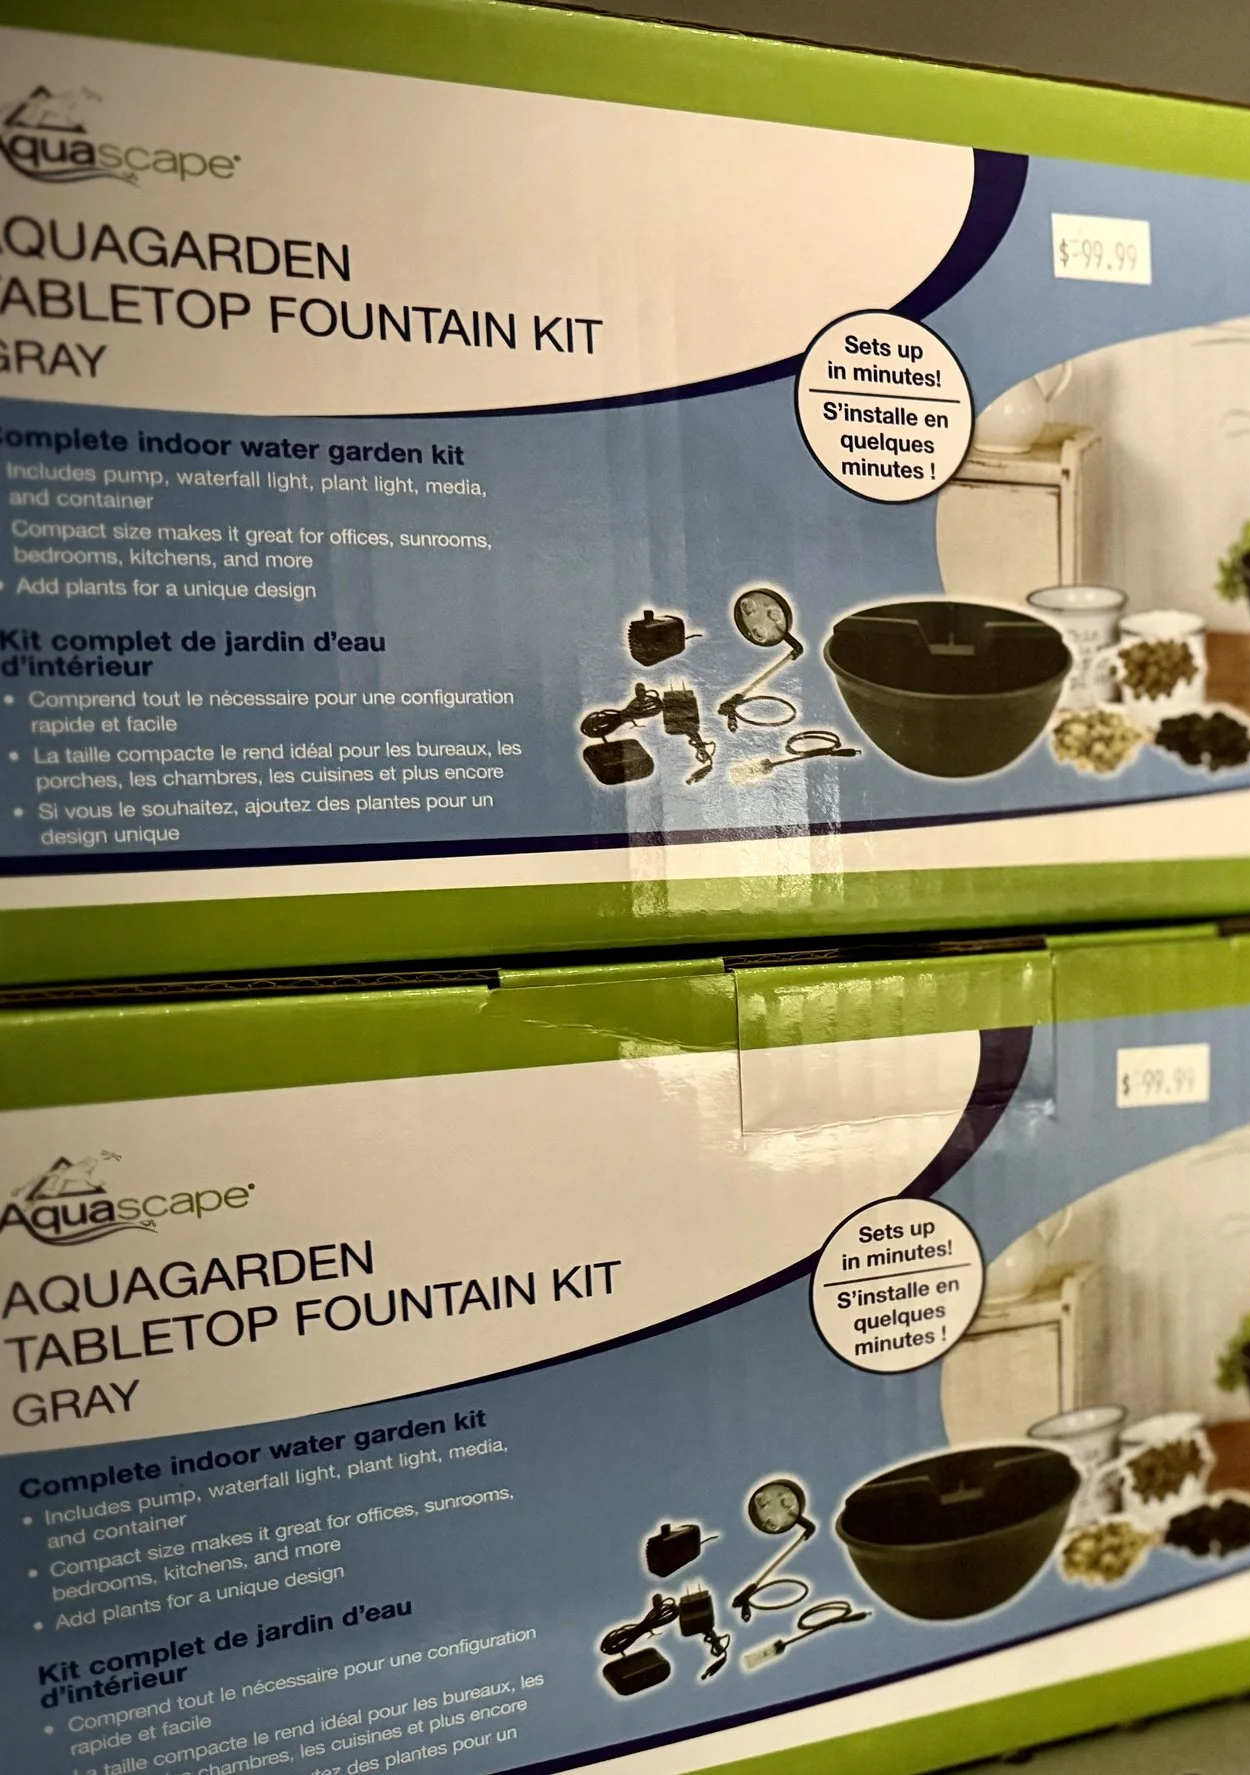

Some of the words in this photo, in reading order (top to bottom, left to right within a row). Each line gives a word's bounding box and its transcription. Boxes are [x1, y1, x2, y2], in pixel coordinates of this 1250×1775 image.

[0, 216, 350, 281] QUAGARDEN
[270, 296, 516, 349] FOUNTAIN
[534, 316, 603, 354] KIT
[845, 335, 890, 356] Sets
[898, 344, 923, 362] up
[828, 361, 846, 379] in
[854, 365, 941, 387] minutes!
[823, 402, 918, 425] S'installe
[925, 415, 948, 428] en
[138, 430, 231, 457] indoor
[240, 441, 319, 461] water
[329, 441, 422, 465] garden
[433, 443, 464, 465] kit
[841, 433, 935, 455] quelques
[104, 471, 169, 488] pump,
[177, 470, 259, 488] waterfall
[268, 473, 313, 492] light,
[321, 475, 368, 494] plant
[375, 476, 418, 496] light,
[426, 479, 486, 498] media,
[57, 491, 153, 510] container
[114, 524, 151, 541] size
[158, 525, 221, 542] makes
[246, 528, 292, 547] great
[300, 527, 324, 545] for
[330, 529, 393, 548] offices,
[400, 532, 491, 550] sunrooms,
[130, 550, 216, 570] kitchens,
[224, 552, 258, 569] and
[265, 556, 313, 570] more
[16, 579, 60, 595] Add
[66, 579, 126, 598] plants
[134, 580, 159, 596] for
[184, 581, 248, 600] unique
[255, 581, 316, 600] design
[0, 630, 40, 651] Kit
[51, 632, 171, 656] complet
[181, 632, 216, 652] de
[226, 631, 304, 656] jardin
[29, 691, 136, 710] Comprend
[143, 692, 181, 707] tout
[210, 689, 309, 707] nécessaire
[316, 692, 357, 709] pour
[363, 691, 395, 704] une
[401, 689, 513, 708] configuration
[32, 717, 94, 737] rapide
[127, 715, 176, 733] facile
[65, 748, 110, 763] taille
[117, 747, 214, 766] compacte
[243, 744, 283, 760] rend
[290, 743, 332, 760] idéal
[339, 746, 381, 763] pour
[386, 743, 410, 758] les
[417, 742, 491, 760] bureaux,
[498, 741, 521, 756] les
[37, 773, 122, 792] porches,
[130, 772, 156, 786] les
[163, 769, 262, 787] chambres,
[269, 768, 294, 783] les
[301, 767, 374, 782] cuisines
[403, 765, 439, 784] plus
[445, 765, 504, 780] encore
[65, 805, 113, 818] vous
[143, 799, 239, 818] souhaitez,
[245, 798, 311, 816] ajoutez
[317, 796, 350, 812] des
[356, 794, 421, 814] plantes
[427, 794, 466, 811] pour
[41, 827, 107, 846] design
[114, 826, 180, 845] unique
[859, 1225, 903, 1243] Sets
[911, 1221, 935, 1238] up
[842, 1254, 860, 1270] in
[867, 1239, 952, 1267] minutes!
[2, 1240, 374, 1319] AQUAGARDEN
[838, 1282, 929, 1309] S'installe
[936, 1280, 959, 1293] en
[5, 1305, 278, 1374] TABLETOP
[297, 1272, 536, 1336] FOUNTAIN
[552, 1260, 622, 1301] KIT
[854, 1305, 945, 1334] quelques
[13, 1379, 140, 1427] GRAY
[19, 1458, 161, 1500] Complete
[171, 1446, 261, 1476] indoor
[269, 1433, 346, 1460] water
[354, 1416, 446, 1452] garden
[454, 1410, 487, 1432] kit
[45, 1497, 131, 1526] Includes
[138, 1489, 201, 1513] pump,
[208, 1470, 289, 1499] waterfall
[296, 1465, 341, 1486] light,
[348, 1456, 393, 1478] plant
[399, 1448, 442, 1471] light,
[449, 1438, 508, 1460] media,
[47, 1528, 85, 1550] and
[93, 1512, 187, 1543] container
[50, 1549, 142, 1579] Compact
[147, 1541, 185, 1558] size
[191, 1529, 253, 1553] makes
[275, 1516, 322, 1541] great
[327, 1513, 351, 1530] for
[357, 1501, 419, 1526] offices,
[424, 1485, 514, 1512] sunrooms,
[53, 1568, 158, 1601] bedrooms,
[165, 1553, 248, 1582] kitchens,
[254, 1545, 289, 1565] and
[295, 1537, 341, 1556] more
[56, 1608, 96, 1632] Add
[103, 1598, 162, 1624] plants
[168, 1591, 194, 1609] for
[217, 1579, 280, 1601] unique
[285, 1564, 345, 1589] design
[39, 1662, 80, 1686] Kit
[89, 1636, 206, 1676] complet
[214, 1630, 249, 1651] de
[256, 1613, 335, 1648] jardin
[68, 1700, 172, 1733] Comprend
[176, 1690, 214, 1708] tout
[242, 1665, 339, 1697] nécessaire
[344, 1657, 385, 1680] pour
[389, 1650, 422, 1668] une
[427, 1626, 536, 1660] configuration
[153, 1735, 248, 1766] compacte
[275, 1720, 315, 1740] rend
[321, 1712, 363, 1731] idéal
[368, 1705, 408, 1725] pour
[413, 1693, 437, 1712] les
[443, 1681, 516, 1708] bureaux,
[520, 1671, 545, 1689] les
[300, 1742, 325, 1759] les
[331, 1728, 402, 1752] cuisines
[430, 1714, 465, 1733] plus
[470, 1701, 528, 1722] encore
[71, 1731, 133, 1757] rapide
[162, 1715, 212, 1738] facile
[385, 1743, 448, 1768] plantes
[452, 1735, 492, 1757] pour
